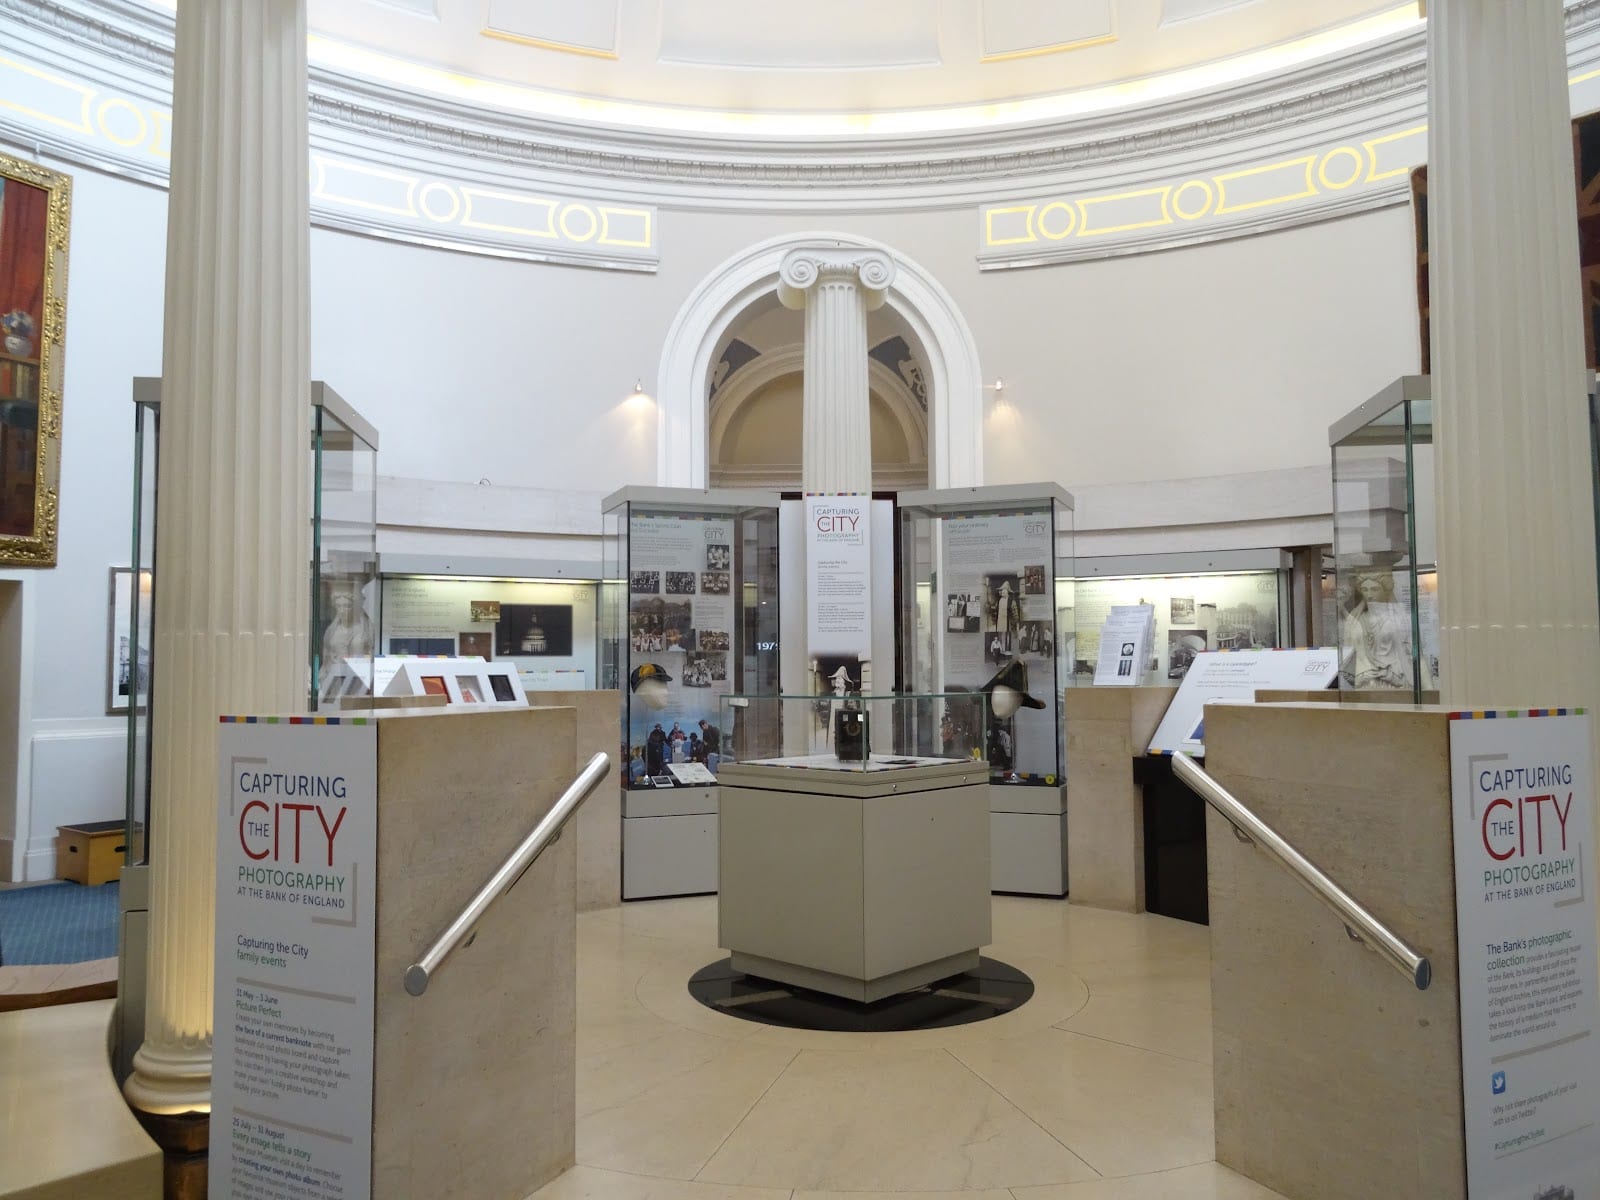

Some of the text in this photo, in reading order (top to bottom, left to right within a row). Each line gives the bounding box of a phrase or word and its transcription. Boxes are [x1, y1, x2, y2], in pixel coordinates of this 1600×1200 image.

[704, 530, 724, 539] CITY
[817, 516, 859, 532] CITY
[1025, 525, 1046, 534] CITY
[240, 772, 346, 798] CAPTURING
[1480, 765, 1572, 792] CAPTURING
[240, 800, 347, 866] CITY
[248, 822, 269, 837] THE
[1482, 792, 1572, 861] CITY
[1491, 821, 1514, 836] THE
[238, 866, 345, 892] PHOTOGRAPHY
[1484, 858, 1575, 887] PHOTOGRAPHY
[237, 886, 345, 908] AT THE BANK OF ENGLAND
[1485, 878, 1576, 904] AT THE BANK OF ENGLAND
[237, 935, 308, 959] Capturing the City
[1486, 930, 1572, 955] The Bank's photographic
[237, 949, 286, 968] family events
[1487, 954, 1525, 970] collection
[236, 1000, 282, 1018] Picture Perfect
[240, 1120, 251, 1131] July
[265, 1127, 284, 1140] August
[232, 1129, 249, 1144] Every
[250, 1136, 270, 1150] image
[272, 1142, 285, 1152] tells
[293, 1148, 311, 1162] story
[285, 1169, 302, 1181] photo
